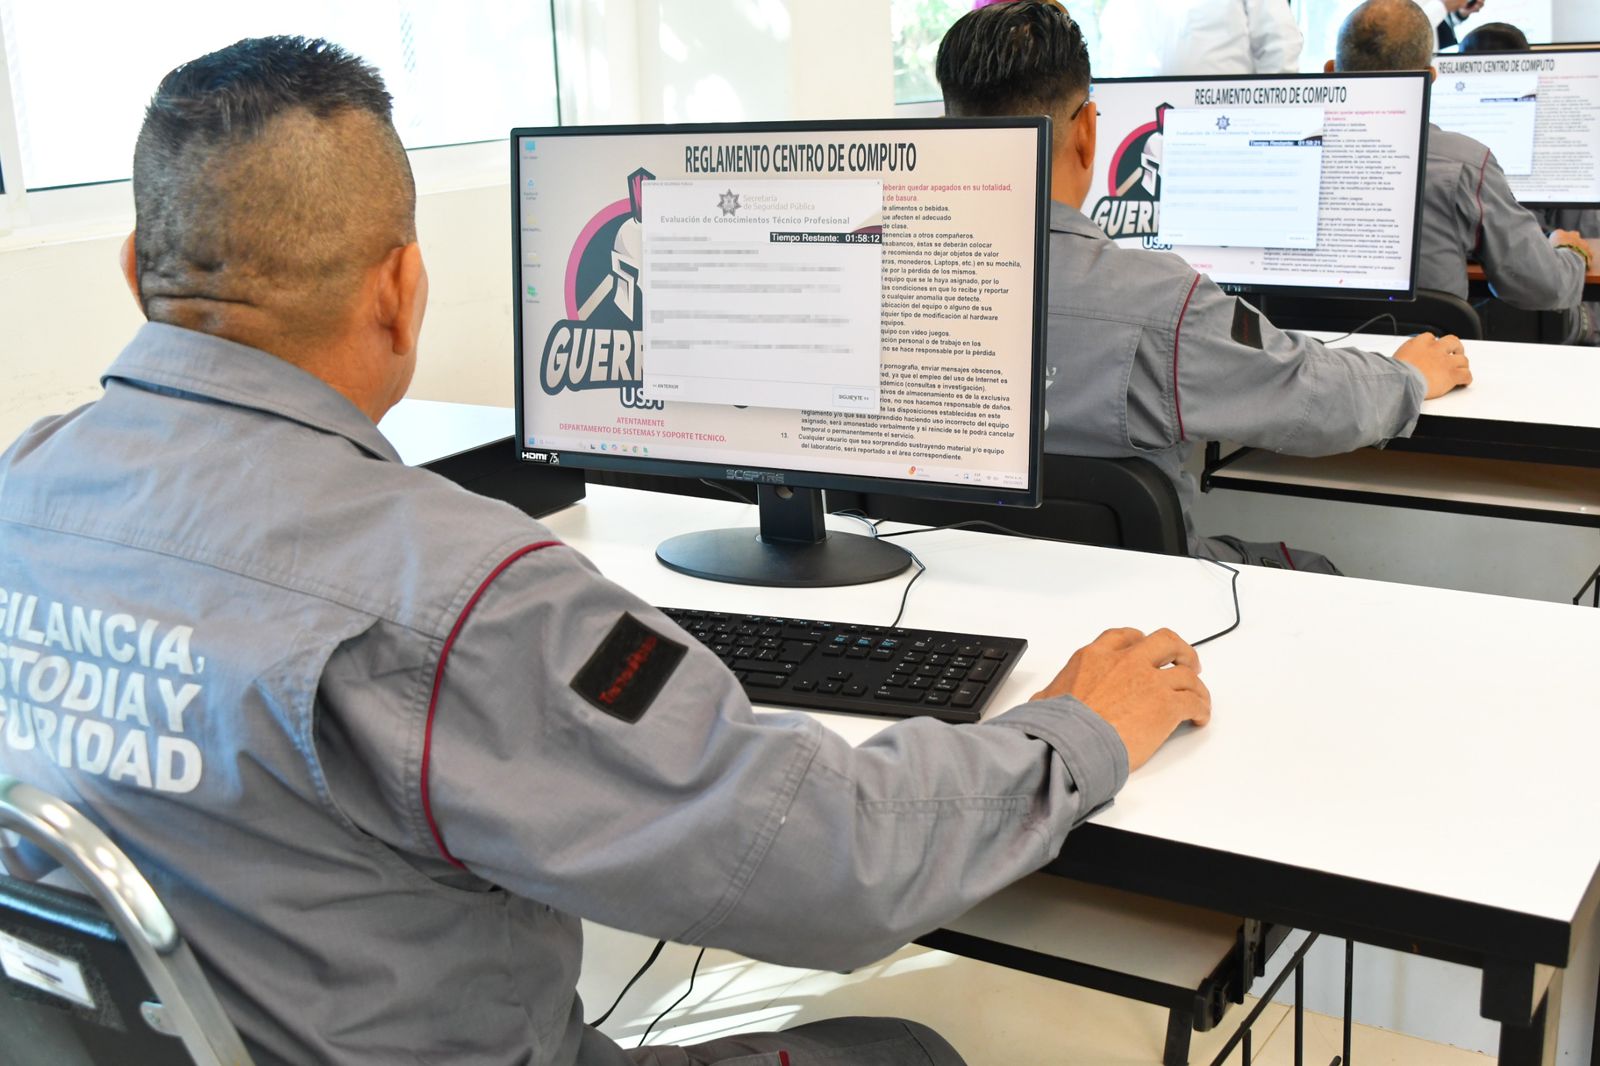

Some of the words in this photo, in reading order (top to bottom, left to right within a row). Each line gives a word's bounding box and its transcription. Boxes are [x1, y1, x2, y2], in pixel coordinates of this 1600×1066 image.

[1195, 88, 1251, 104] REGLAMENTO
[1253, 88, 1287, 104] CENTRO
[1289, 87, 1300, 103] DE
[1302, 86, 1347, 103] COMPUTO
[685, 145, 770, 173] REGLAMENTO
[773, 144, 824, 172] CENTRO
[827, 144, 844, 171] DE
[848, 143, 916, 171] COMPUTO
[908, 183, 928, 192] quedar
[931, 183, 960, 192] apagados
[753, 203, 788, 212] Seguridad
[790, 202, 815, 210] Pública
[773, 216, 802, 224] Técnico
[772, 233, 799, 243] Tiempo
[802, 234, 839, 242] Restante:
[845, 234, 880, 242] 01:58:12
[934, 249, 948, 258] dejar
[950, 249, 972, 258] objetos
[962, 258, 975, 268] etc.)
[885, 275, 904, 284] equipo
[934, 276, 948, 285] haya
[984, 286, 1008, 295] reportar
[887, 292, 914, 302] cualquier
[922, 302, 942, 311] equipo
[950, 303, 970, 312] alguno
[901, 310, 912, 319] tipo
[970, 312, 998, 320] hardware
[881, 327, 897, 336] quipo
[899, 337, 924, 345] personal
[940, 338, 960, 347] trabajo
[916, 347, 952, 355] responsable
[941, 366, 969, 375] mensajes
[920, 373, 941, 382] empleo
[976, 375, 998, 383] Internet
[905, 380, 935, 389] (consultas
[906, 389, 954, 398] almacenamiento
[981, 393, 1009, 401] exclusiva
[916, 398, 942, 406] hacemos
[944, 401, 981, 409] responsable
[897, 405, 938, 415] disposiciones
[939, 408, 976, 417] establecidas
[617, 417, 664, 427] ATENTAMENTE
[801, 408, 832, 418] reglamento
[868, 414, 902, 422] sorprendido
[904, 414, 931, 423] haciendo
[945, 417, 975, 426] incorrecto
[988, 420, 1009, 430] equipo
[801, 424, 825, 434] temporal
[832, 428, 882, 437] permanentemente
[843, 420, 878, 428] amonestado
[880, 422, 915, 431] verbalmente
[929, 425, 952, 433] reincide
[560, 423, 611, 434] DEPARTAMENTO
[623, 428, 655, 437] SISTEMAS
[662, 430, 693, 439] SOPORTE
[695, 433, 726, 442] TECNICO.
[799, 432, 825, 442] Cualquier
[873, 439, 907, 448] sorprendido
[909, 441, 945, 451] sustrayendo
[947, 443, 971, 452] material
[984, 446, 1004, 456] equipo
[858, 446, 885, 455] reportado
[522, 452, 548, 460] HDMI
[726, 469, 784, 484] SCEPTRE
[158, 678, 202, 732] Y
[0, 694, 202, 793] URIDAD
